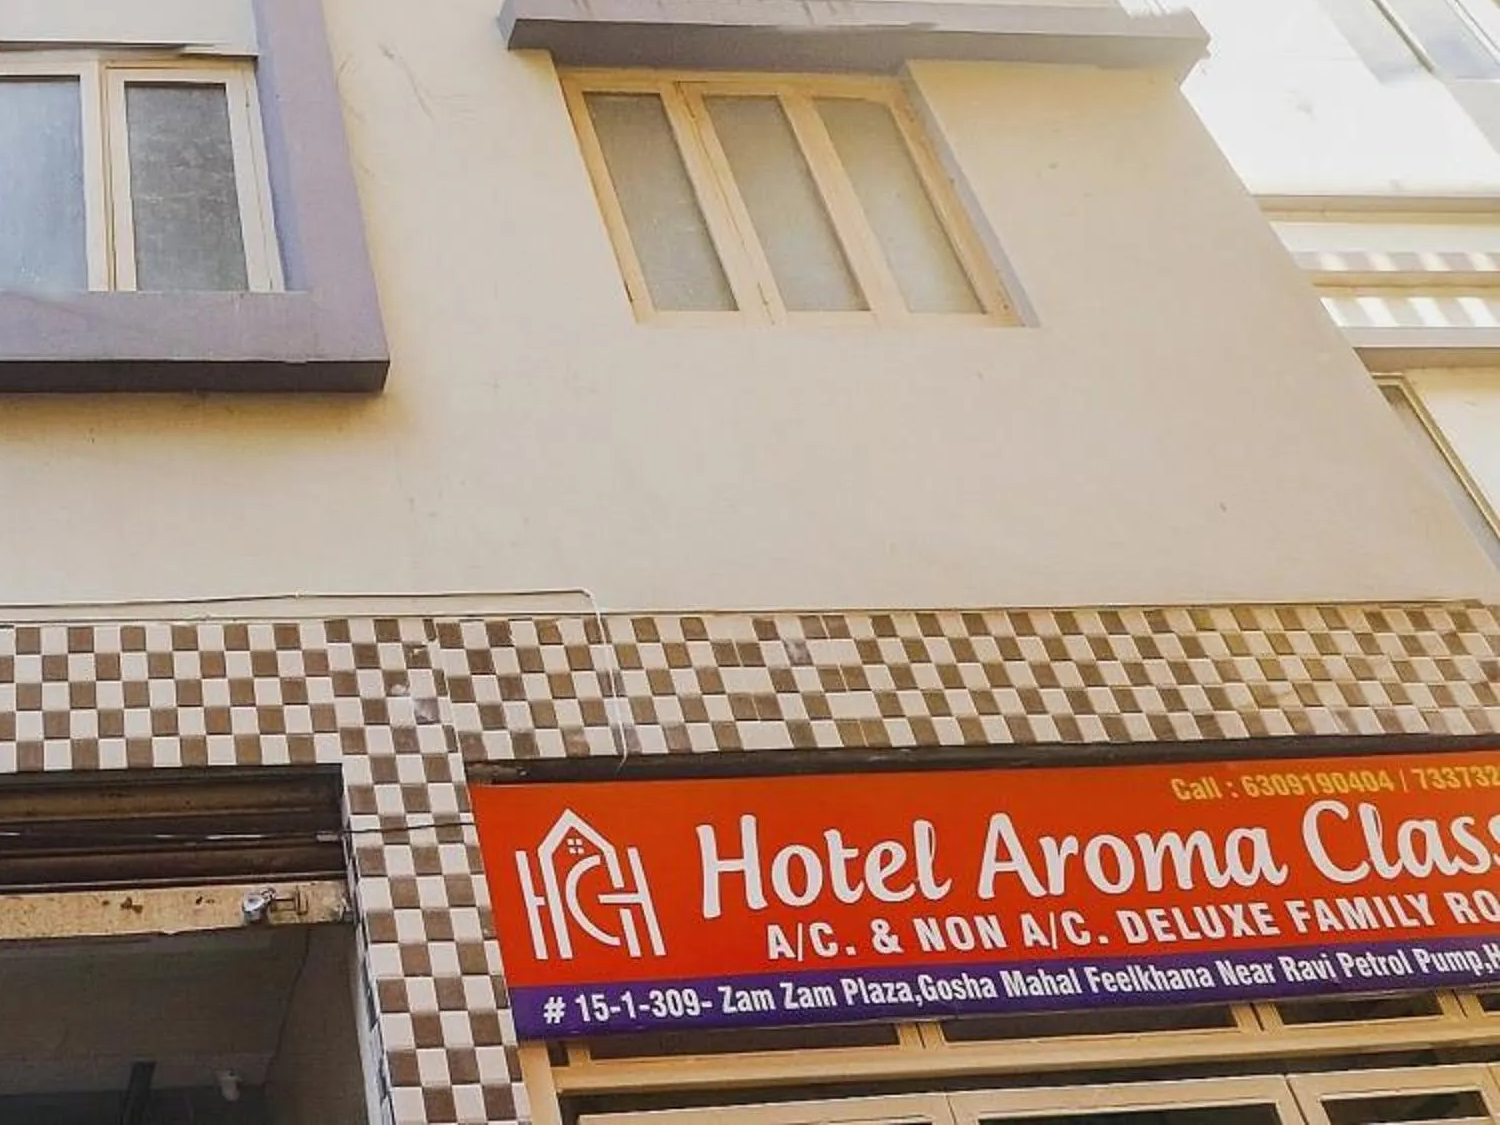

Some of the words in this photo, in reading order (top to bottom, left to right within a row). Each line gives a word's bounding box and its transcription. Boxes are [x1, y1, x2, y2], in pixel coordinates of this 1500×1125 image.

[1171, 776, 1223, 800] Call
[1241, 769, 1395, 798] 6309190404
[694, 813, 953, 920] Hotel
[976, 811, 1289, 900] Aroma
[766, 922, 858, 962] A/C.
[870, 917, 905, 955] &
[913, 913, 1008, 953] NON
[1021, 908, 1110, 951] A/C.
[1117, 901, 1281, 945] DELUXE
[1284, 892, 1437, 934] FAMILY
[543, 996, 566, 1025] #
[575, 989, 713, 1024] 15-1-309-
[717, 984, 776, 1015] Zam
[779, 980, 837, 1011] Zam
[999, 966, 1082, 999] Mahal
[1083, 960, 1216, 995] Feelkhana
[1215, 958, 1277, 988] Near
[1277, 952, 1338, 983] Ravi
[1336, 948, 1412, 980] Petrol
